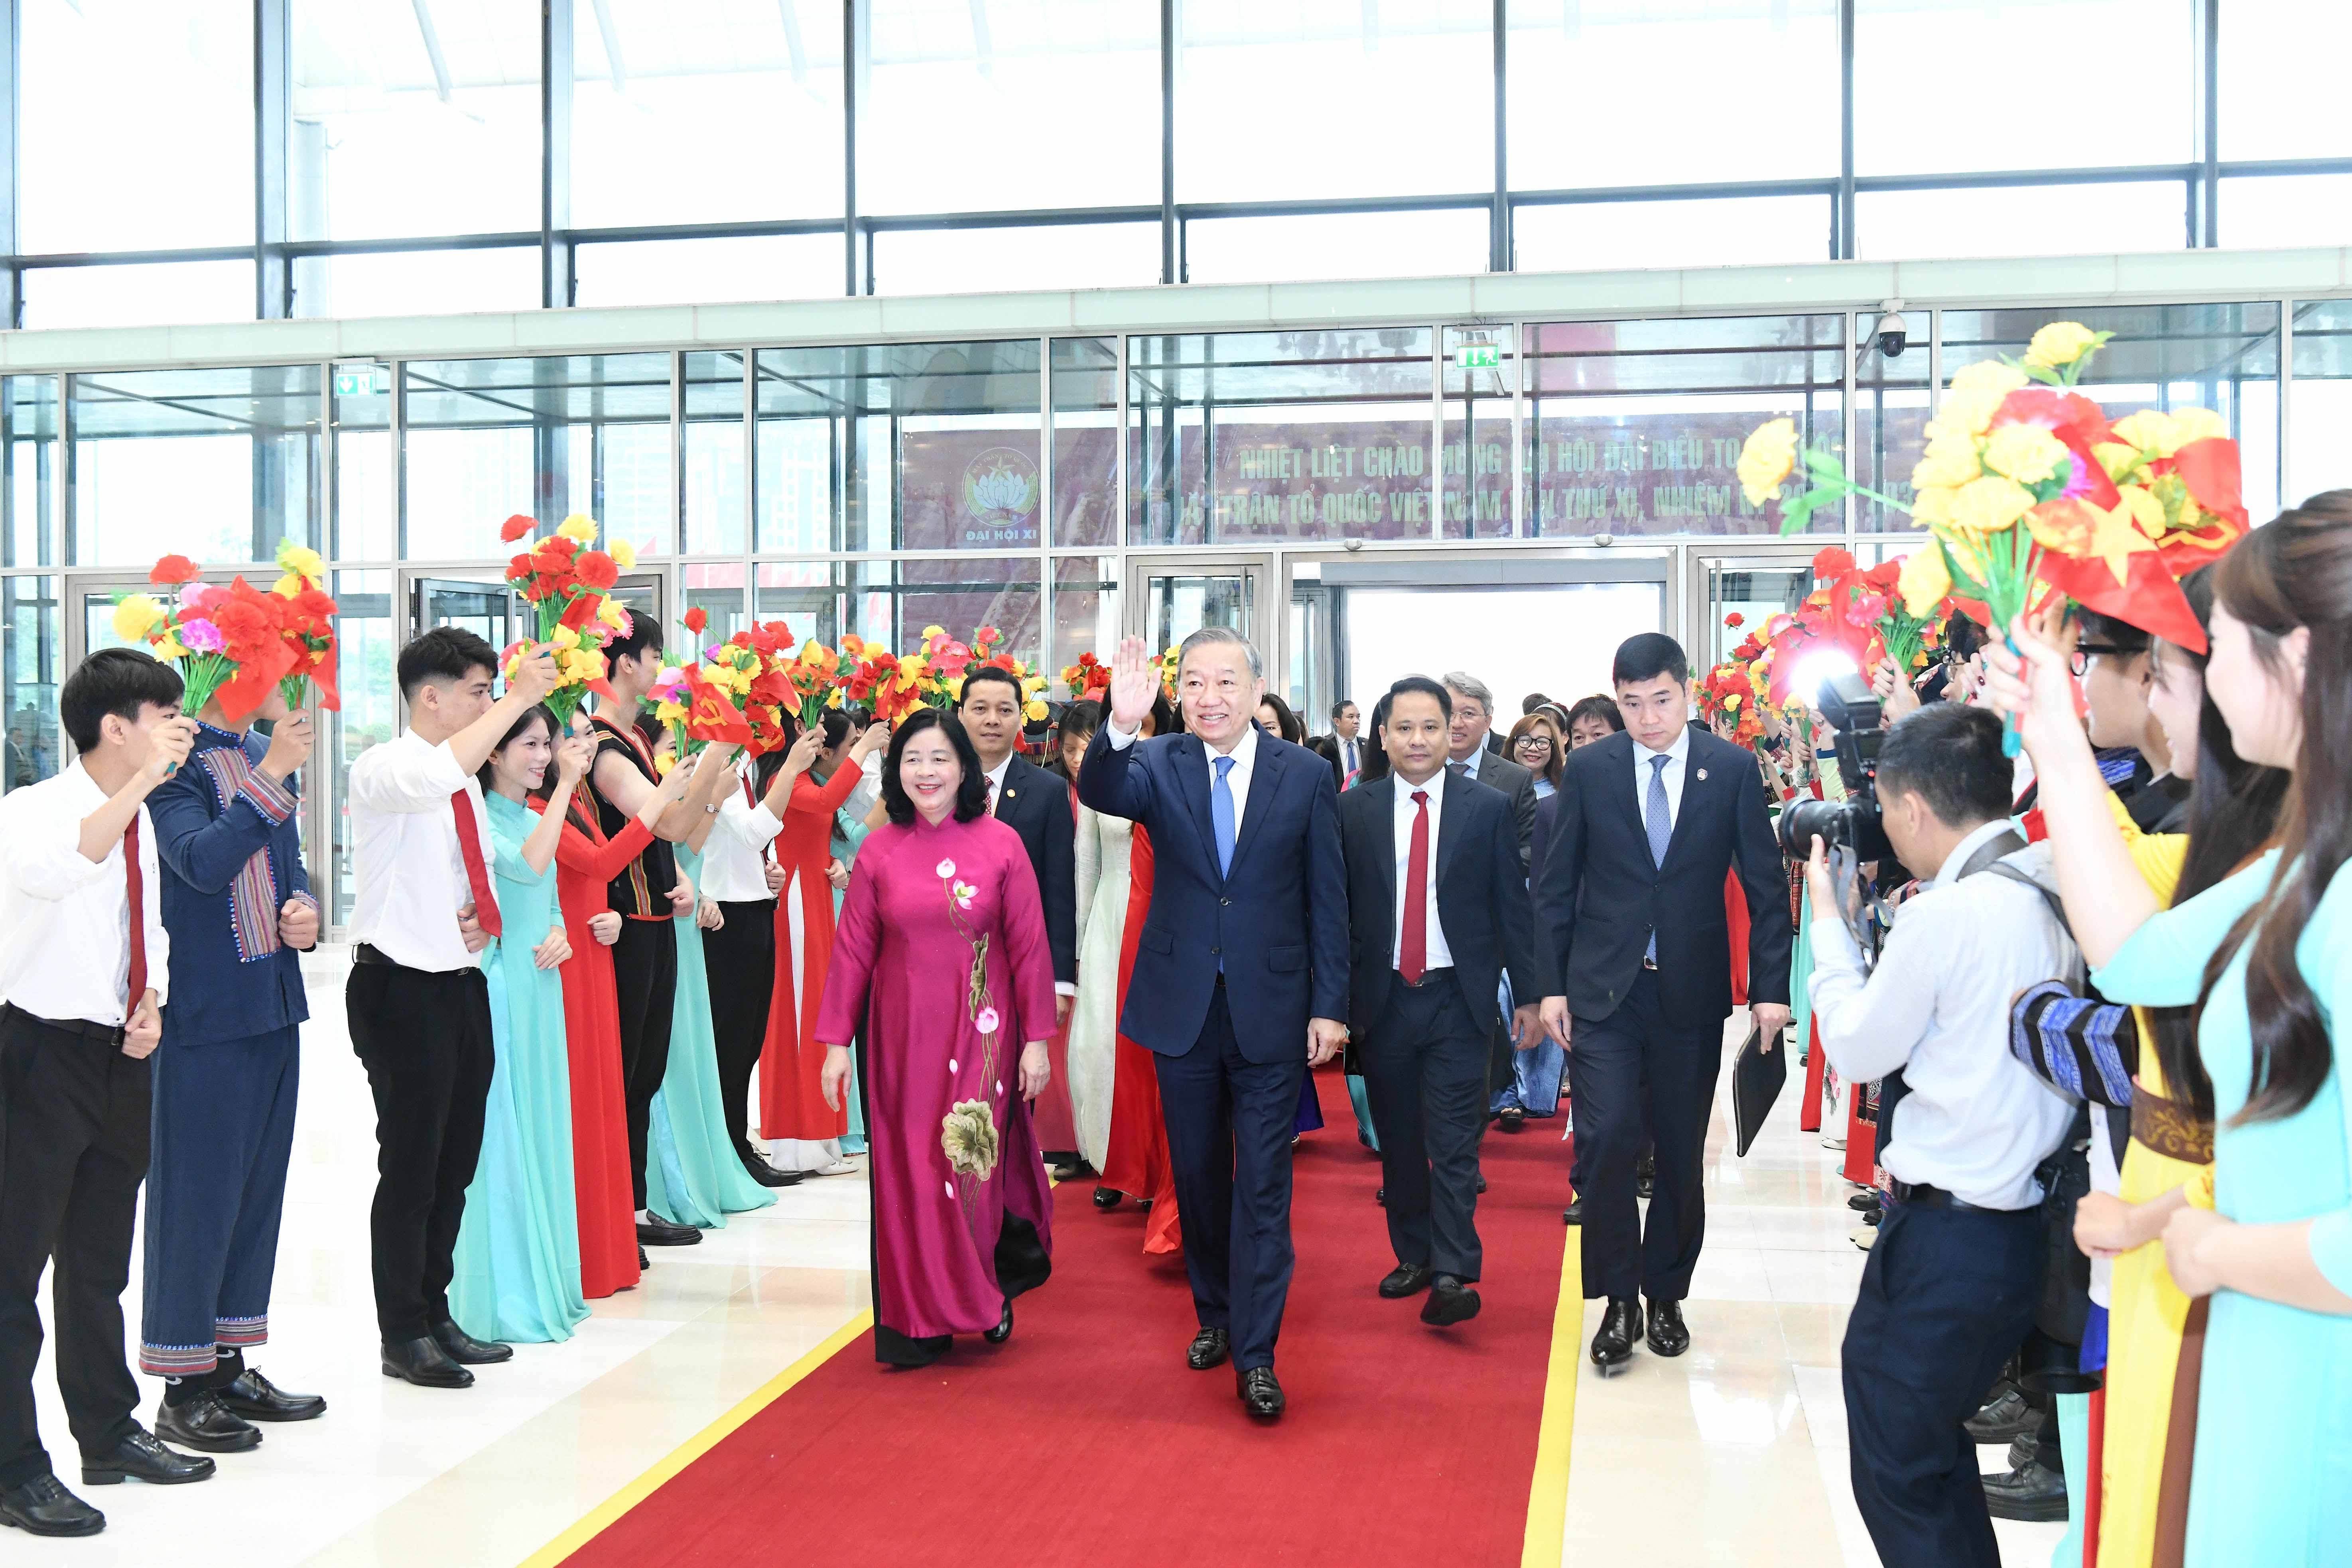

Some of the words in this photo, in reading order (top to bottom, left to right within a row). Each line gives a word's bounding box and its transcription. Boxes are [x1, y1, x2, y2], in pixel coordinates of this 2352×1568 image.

[1240, 444, 1304, 484] NHIỆT
[1311, 443, 1356, 483] LIỆT
[1363, 440, 1424, 478] CHÀO
[1557, 437, 1595, 479] HỘI
[1219, 491, 1279, 529] TRẬN
[1287, 484, 1315, 524] TỔ
[1323, 485, 1382, 527] QUỐC
[1653, 480, 1730, 522] NHIỆM
[966, 530, 990, 542] ĐẠI
[995, 528, 1018, 542] HỘI
[1022, 530, 1037, 539] XI
